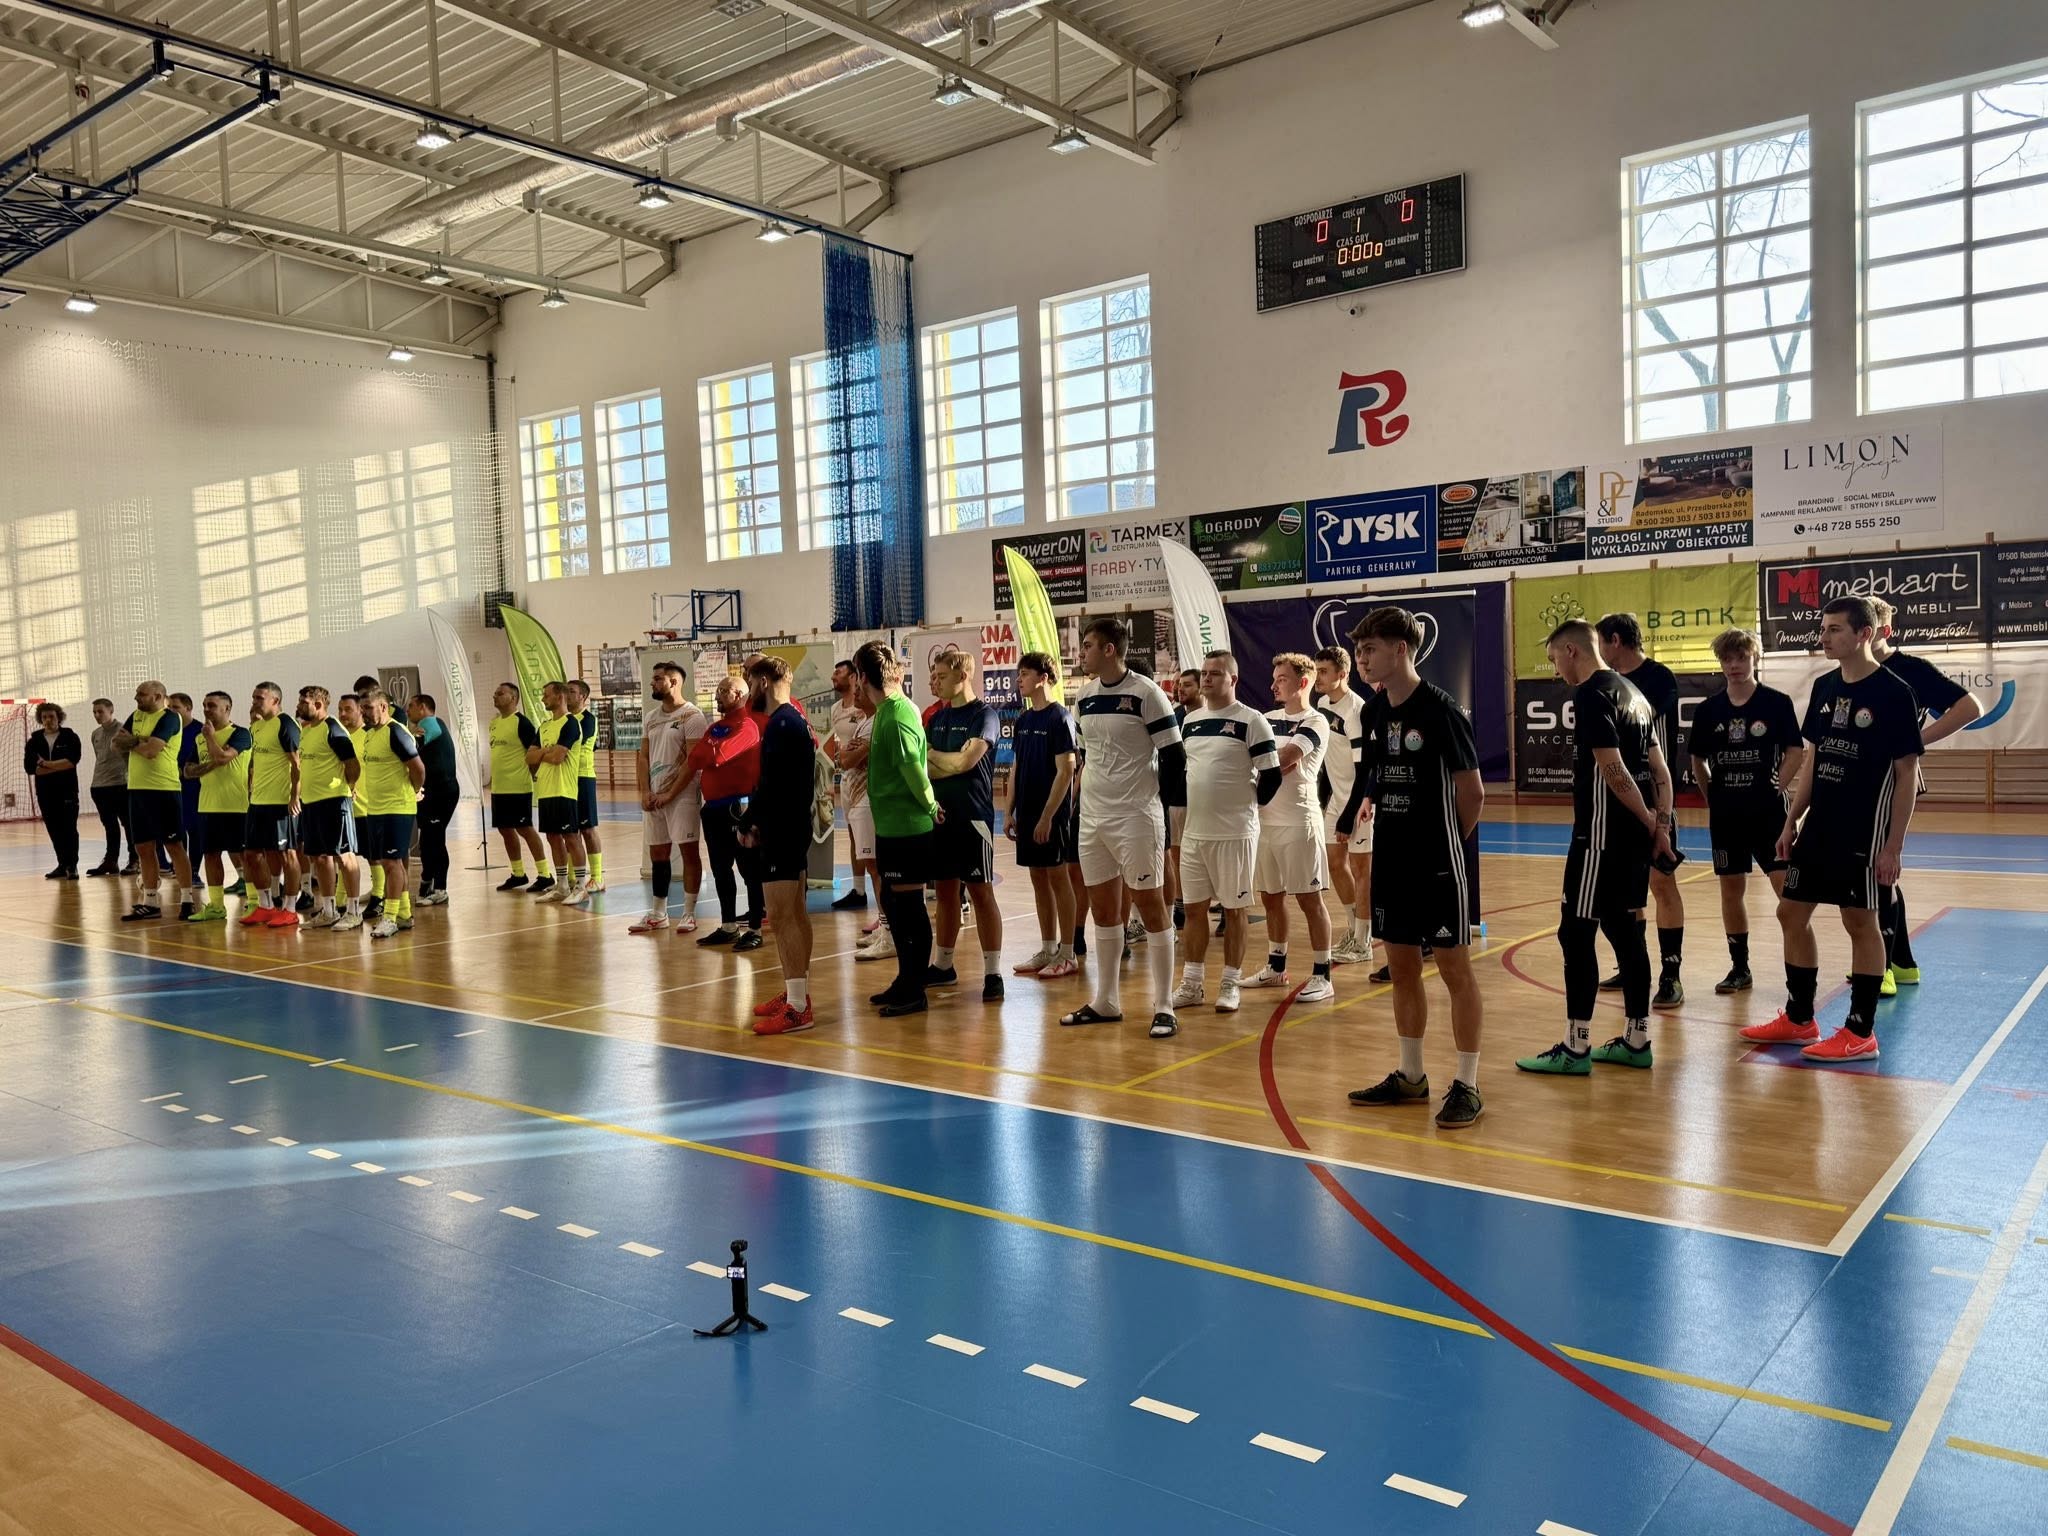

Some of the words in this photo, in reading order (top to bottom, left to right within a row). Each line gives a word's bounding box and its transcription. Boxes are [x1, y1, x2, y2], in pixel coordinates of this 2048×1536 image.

[1401, 199, 1414, 222] 0
[1317, 219, 1329, 243] 0
[1336, 236, 1354, 249] CZAS
[1355, 232, 1370, 245] GRY
[1342, 268, 1356, 279] TIME
[1356, 265, 1369, 275] OUT
[1784, 433, 1911, 471] LIMON
[1687, 502, 1732, 512] Przedborska
[1760, 508, 1797, 519] KAMPANIE
[1798, 505, 1843, 516] REKLAMOWE
[1850, 501, 1879, 510] STRONY
[1884, 498, 1913, 507] SKLEPY
[1915, 495, 1937, 504] WWW
[1798, 496, 1835, 507] BRANDING
[1843, 493, 1870, 502] SOCIAL
[1871, 491, 1895, 500] MEDIA
[1205, 516, 1263, 534] OGRODY
[1597, 516, 1623, 525] STUDIO
[1643, 518, 1658, 526] 500
[1660, 517, 1675, 525] 290
[1677, 515, 1691, 523] 303
[1698, 513, 1714, 521] 503
[1715, 511, 1731, 519] 813
[1733, 509, 1748, 518] 961
[1807, 522, 1828, 534] +48
[1831, 520, 1852, 531] 728
[1855, 518, 1876, 529] 555
[1879, 516, 1901, 527] 250
[1111, 521, 1185, 543] TARMEX
[1337, 510, 1421, 546] JYSK
[1591, 531, 1641, 545] PODŁOGI
[1655, 527, 1692, 539] DRZWI
[1705, 522, 1748, 535] TAPETY
[1199, 531, 1240, 544] PINOSA
[1591, 541, 1667, 556] WYKŁADZINY
[1676, 534, 1748, 549] OBIEKTOWE
[1111, 542, 1145, 552] CENTRUM
[1463, 553, 1489, 561] LUSTRA
[1495, 549, 1524, 558] GRAFIKA
[1537, 546, 1558, 554] SZKLE
[1091, 560, 1137, 576] FARBY
[1326, 565, 1362, 577] PARTNER
[1368, 560, 1417, 573] GENERALNY
[1473, 560, 1498, 568] KABINY
[1499, 555, 1548, 566] PRYSZNICOWE
[1257, 570, 1303, 582] www.pinosa.pl
[1822, 563, 1969, 599] meblart
[1906, 603, 1951, 615] MEBLI
[985, 676, 1011, 691] 918
[1006, 692, 1018, 703] 51
